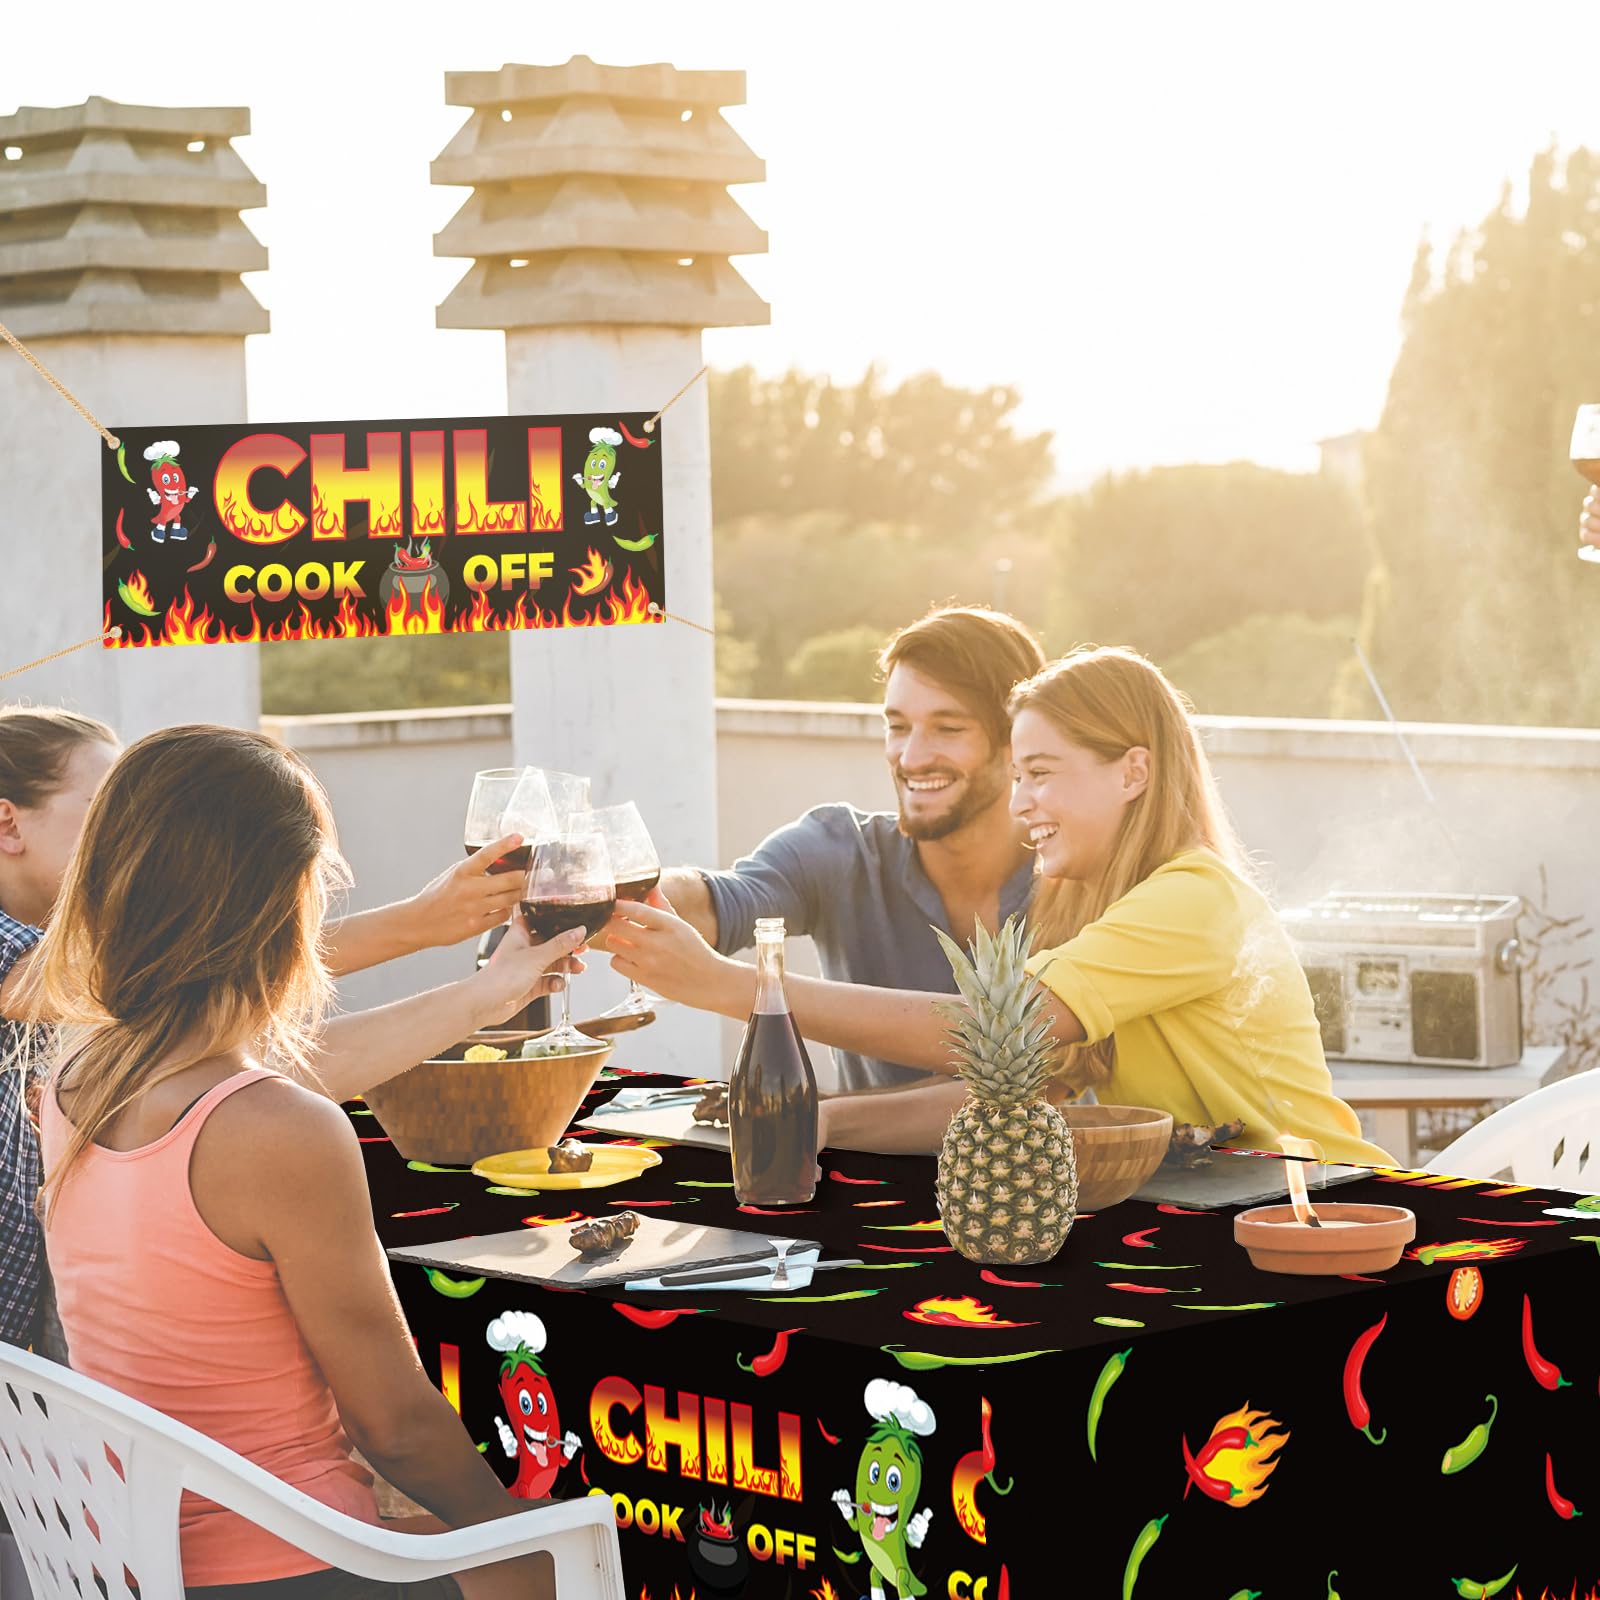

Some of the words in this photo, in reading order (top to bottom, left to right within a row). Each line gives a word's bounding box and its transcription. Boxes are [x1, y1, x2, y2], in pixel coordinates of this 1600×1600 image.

[213, 427, 564, 545] CHILI
[223, 560, 367, 603] COOK
[463, 553, 555, 592] OFF
[589, 1376, 802, 1502] CHILI
[588, 1487, 685, 1542] OOK
[747, 1523, 816, 1570] OFF
